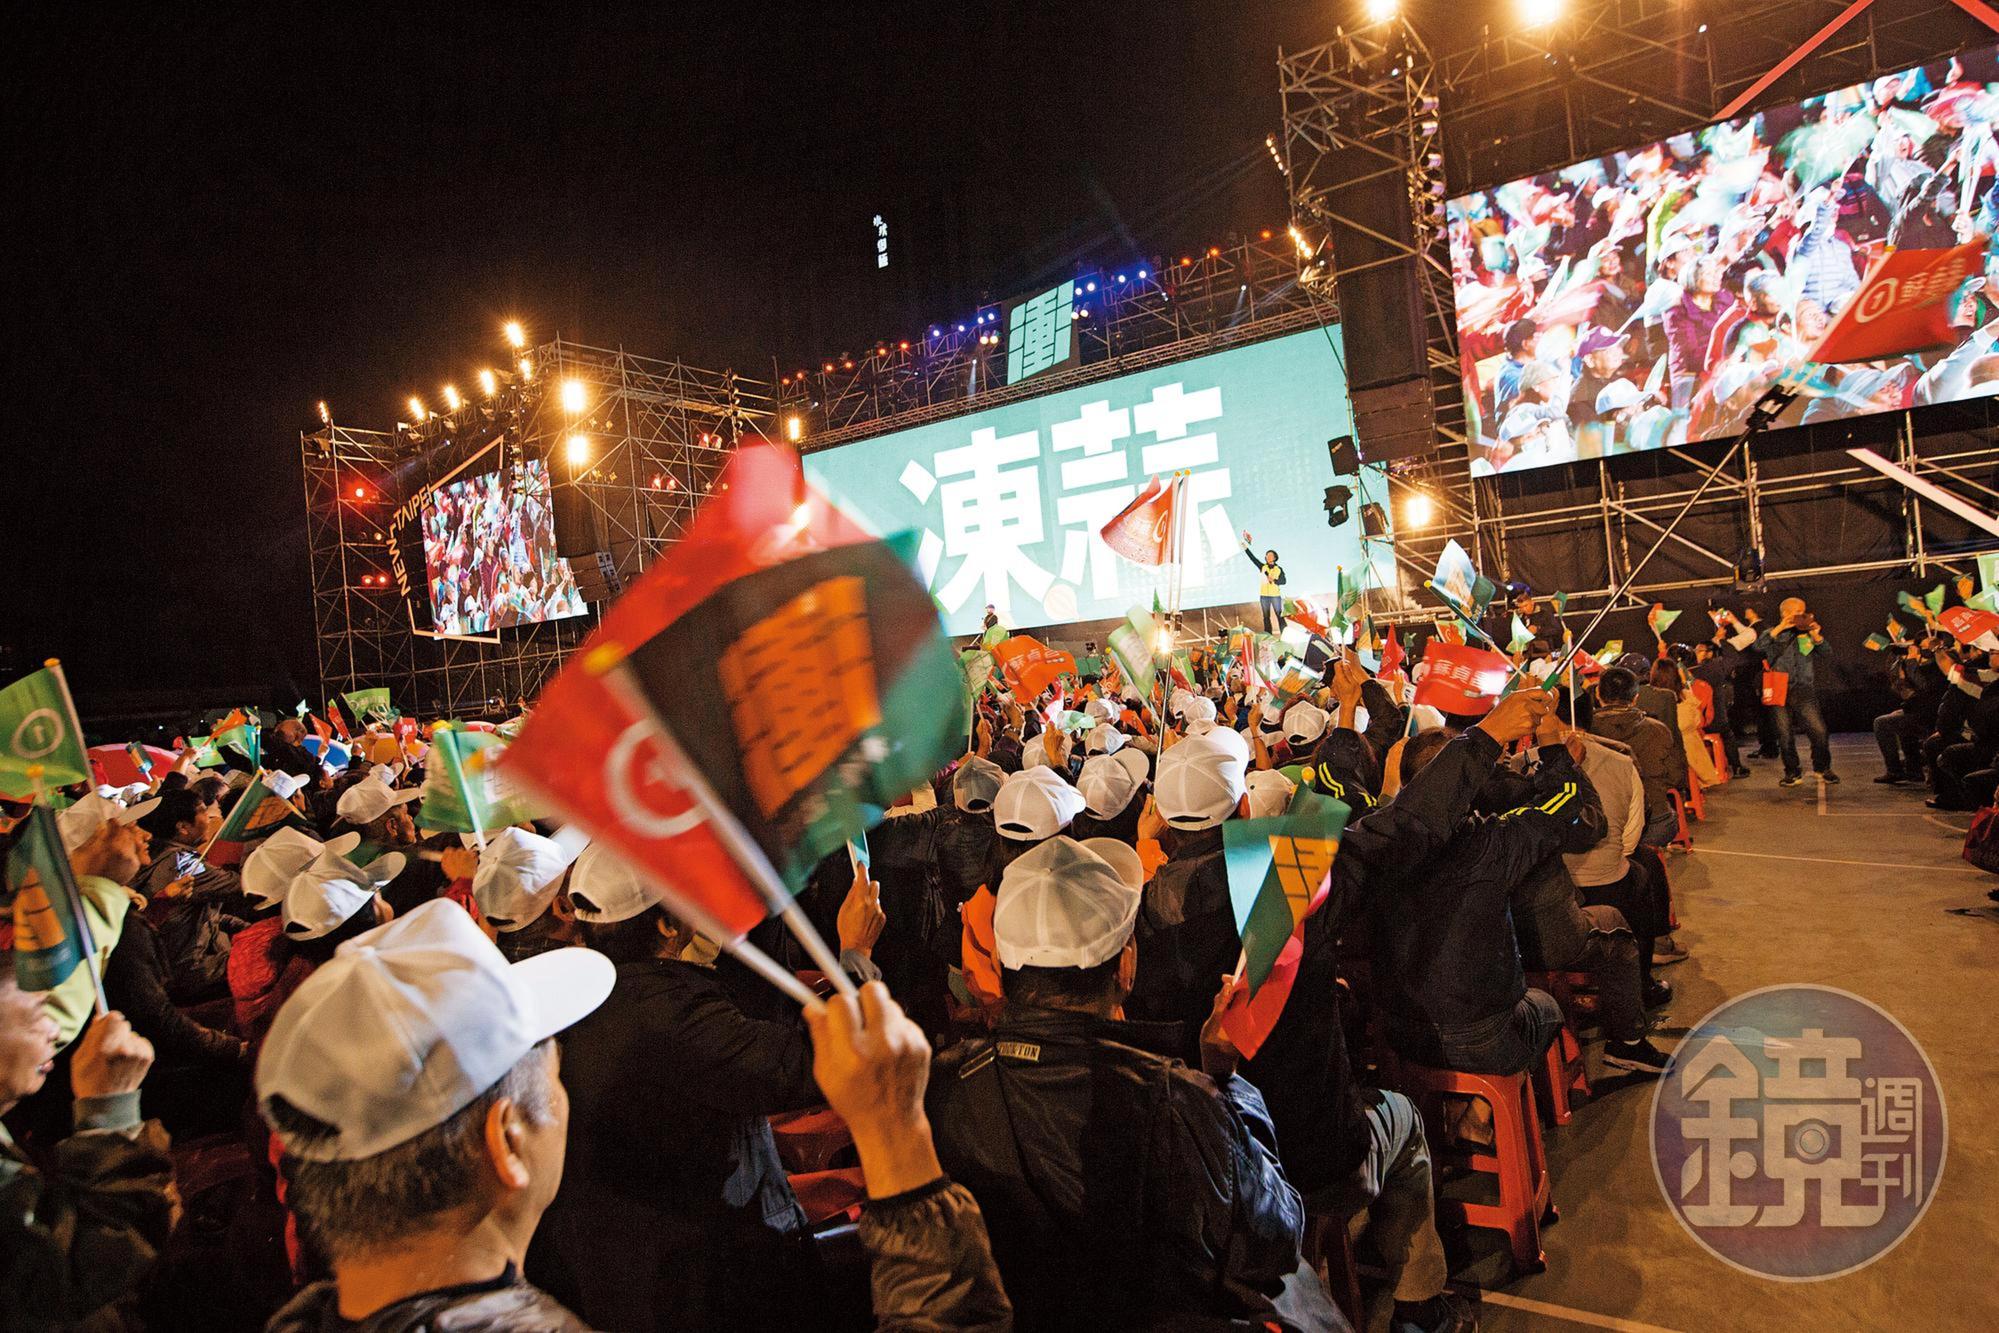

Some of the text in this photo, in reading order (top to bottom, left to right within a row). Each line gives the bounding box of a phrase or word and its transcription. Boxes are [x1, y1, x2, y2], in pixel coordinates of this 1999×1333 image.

[1007, 280, 1074, 385] 衝
[386, 483, 433, 596] NEW TAIPEI
[899, 383, 1240, 615] 凍蒜
